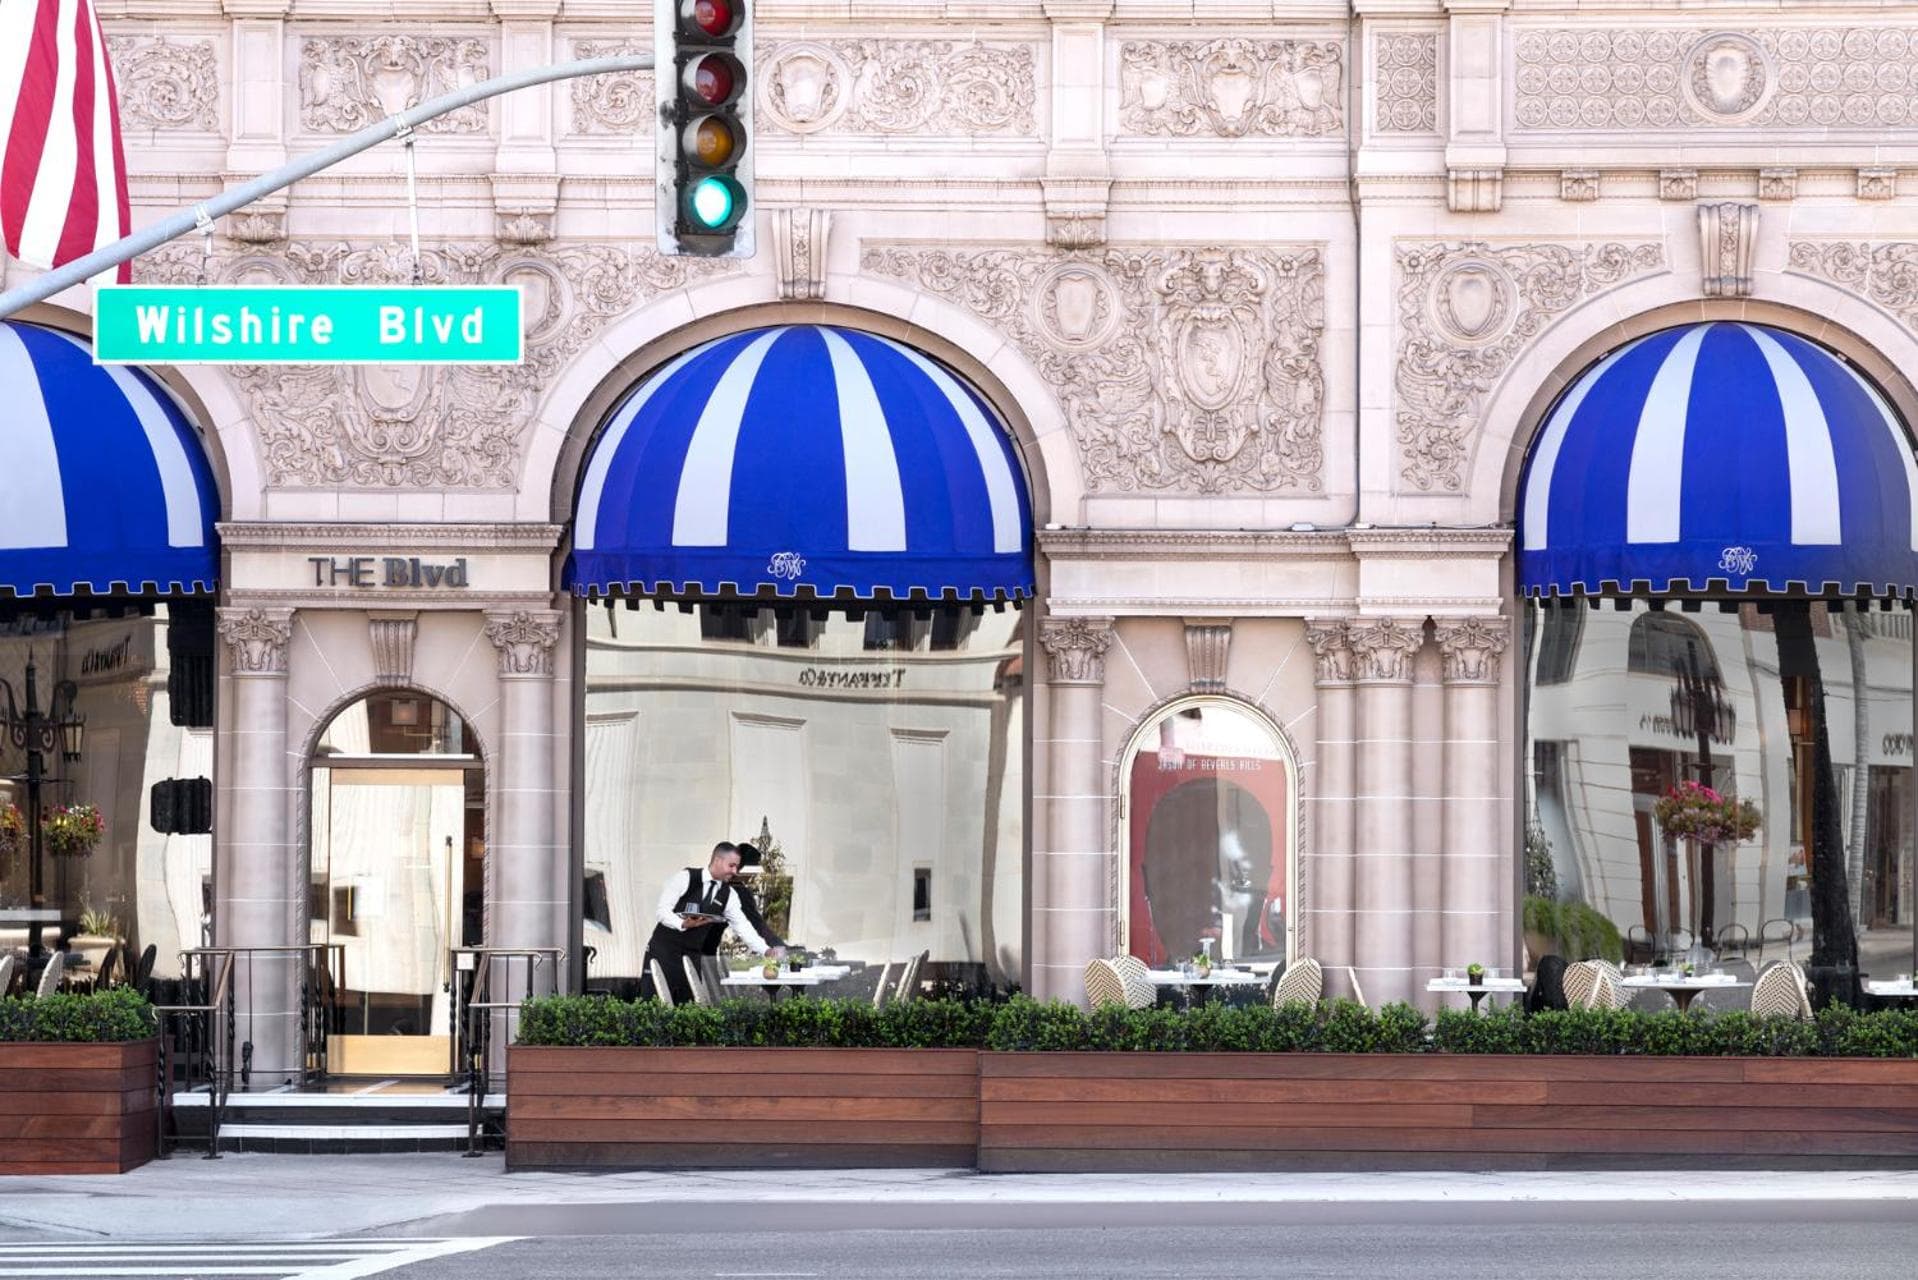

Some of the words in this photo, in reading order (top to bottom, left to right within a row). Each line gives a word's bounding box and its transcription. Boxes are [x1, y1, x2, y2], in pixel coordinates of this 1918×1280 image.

[135, 305, 334, 344] Wilshire
[379, 306, 483, 344] Blvd
[308, 557, 375, 587] THE
[382, 557, 469, 587] Blvd
